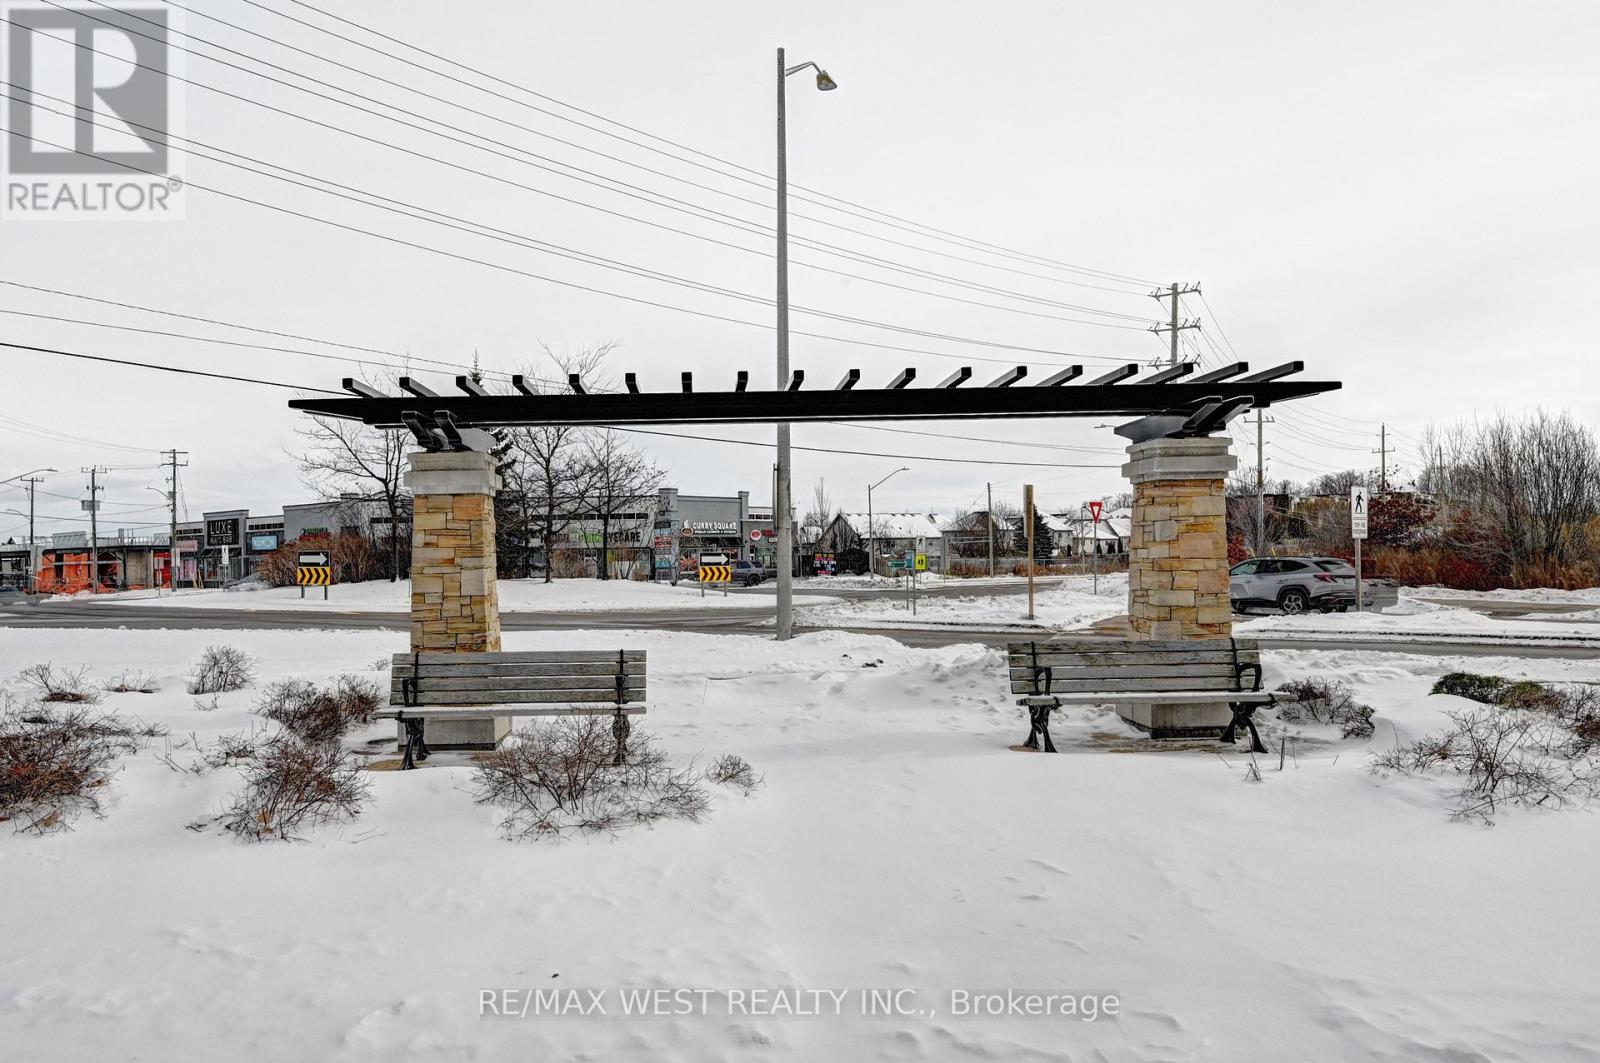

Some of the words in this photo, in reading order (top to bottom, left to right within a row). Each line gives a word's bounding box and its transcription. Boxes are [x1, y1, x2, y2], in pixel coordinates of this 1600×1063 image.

[210, 520, 232, 534] LUXE
[692, 522, 713, 530] CURRY
[713, 522, 737, 530] SQUARE
[222, 535, 232, 544] BAR
[607, 531, 641, 543] YECARE
